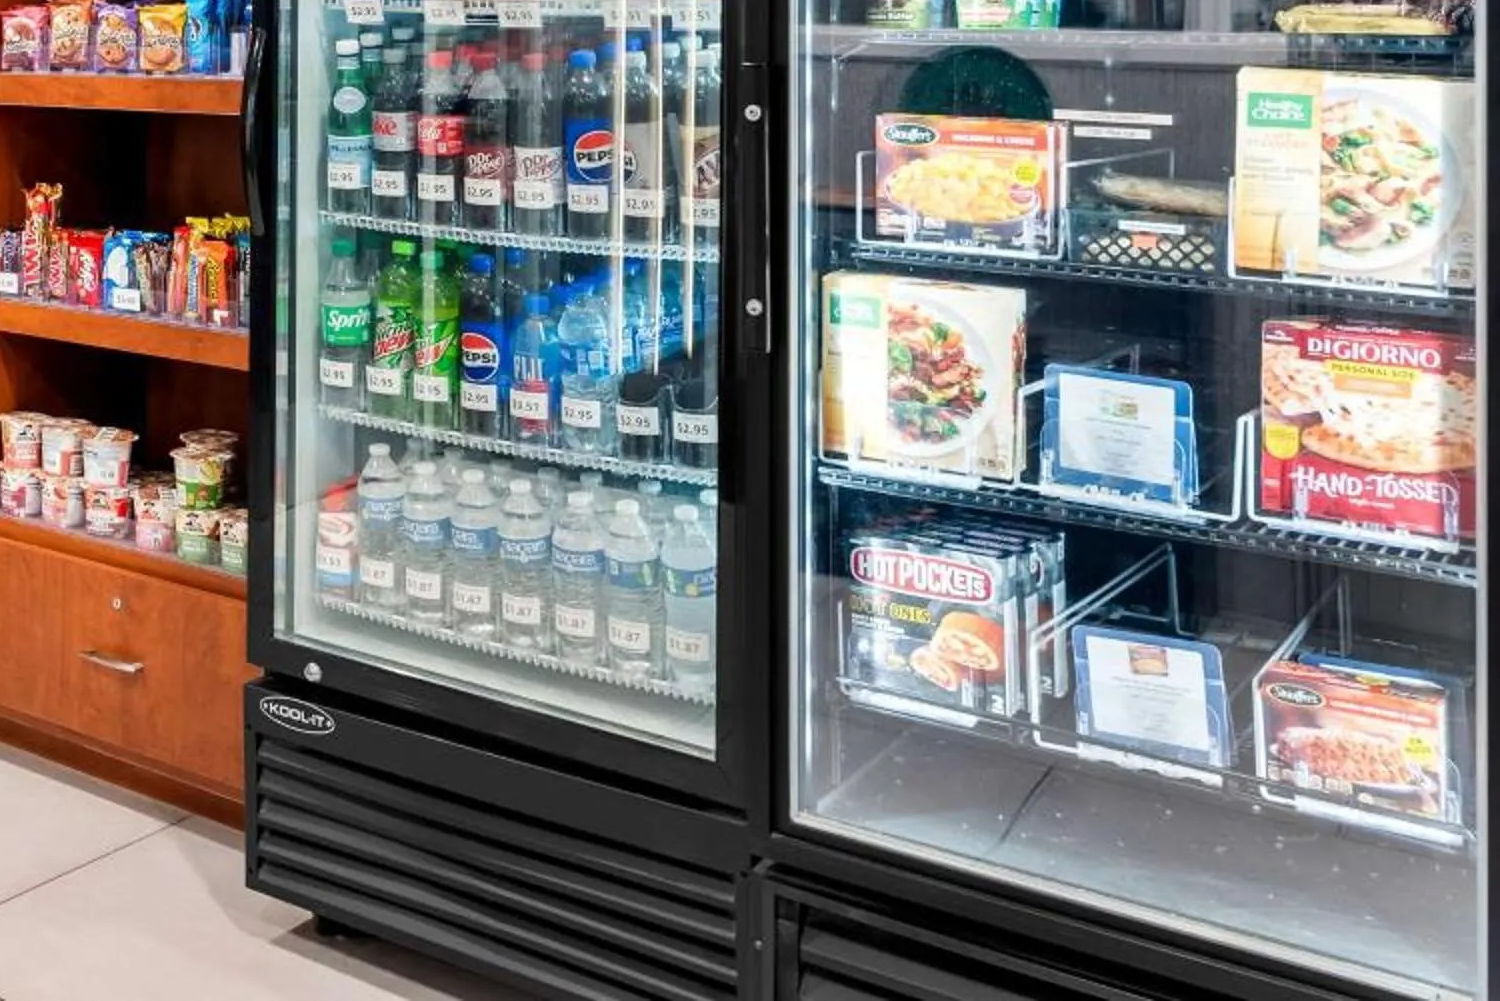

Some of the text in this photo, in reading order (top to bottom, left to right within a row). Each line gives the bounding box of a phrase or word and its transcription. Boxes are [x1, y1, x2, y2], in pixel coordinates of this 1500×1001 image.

[1331, 363, 1416, 380] PERSONAL SIZE
[564, 406, 593, 420] $2.95
[620, 414, 650, 428] $2.95
[677, 423, 709, 436] $2.95
[857, 550, 987, 600] HOT POCKETS
[269, 701, 325, 728] KOOL-IT
